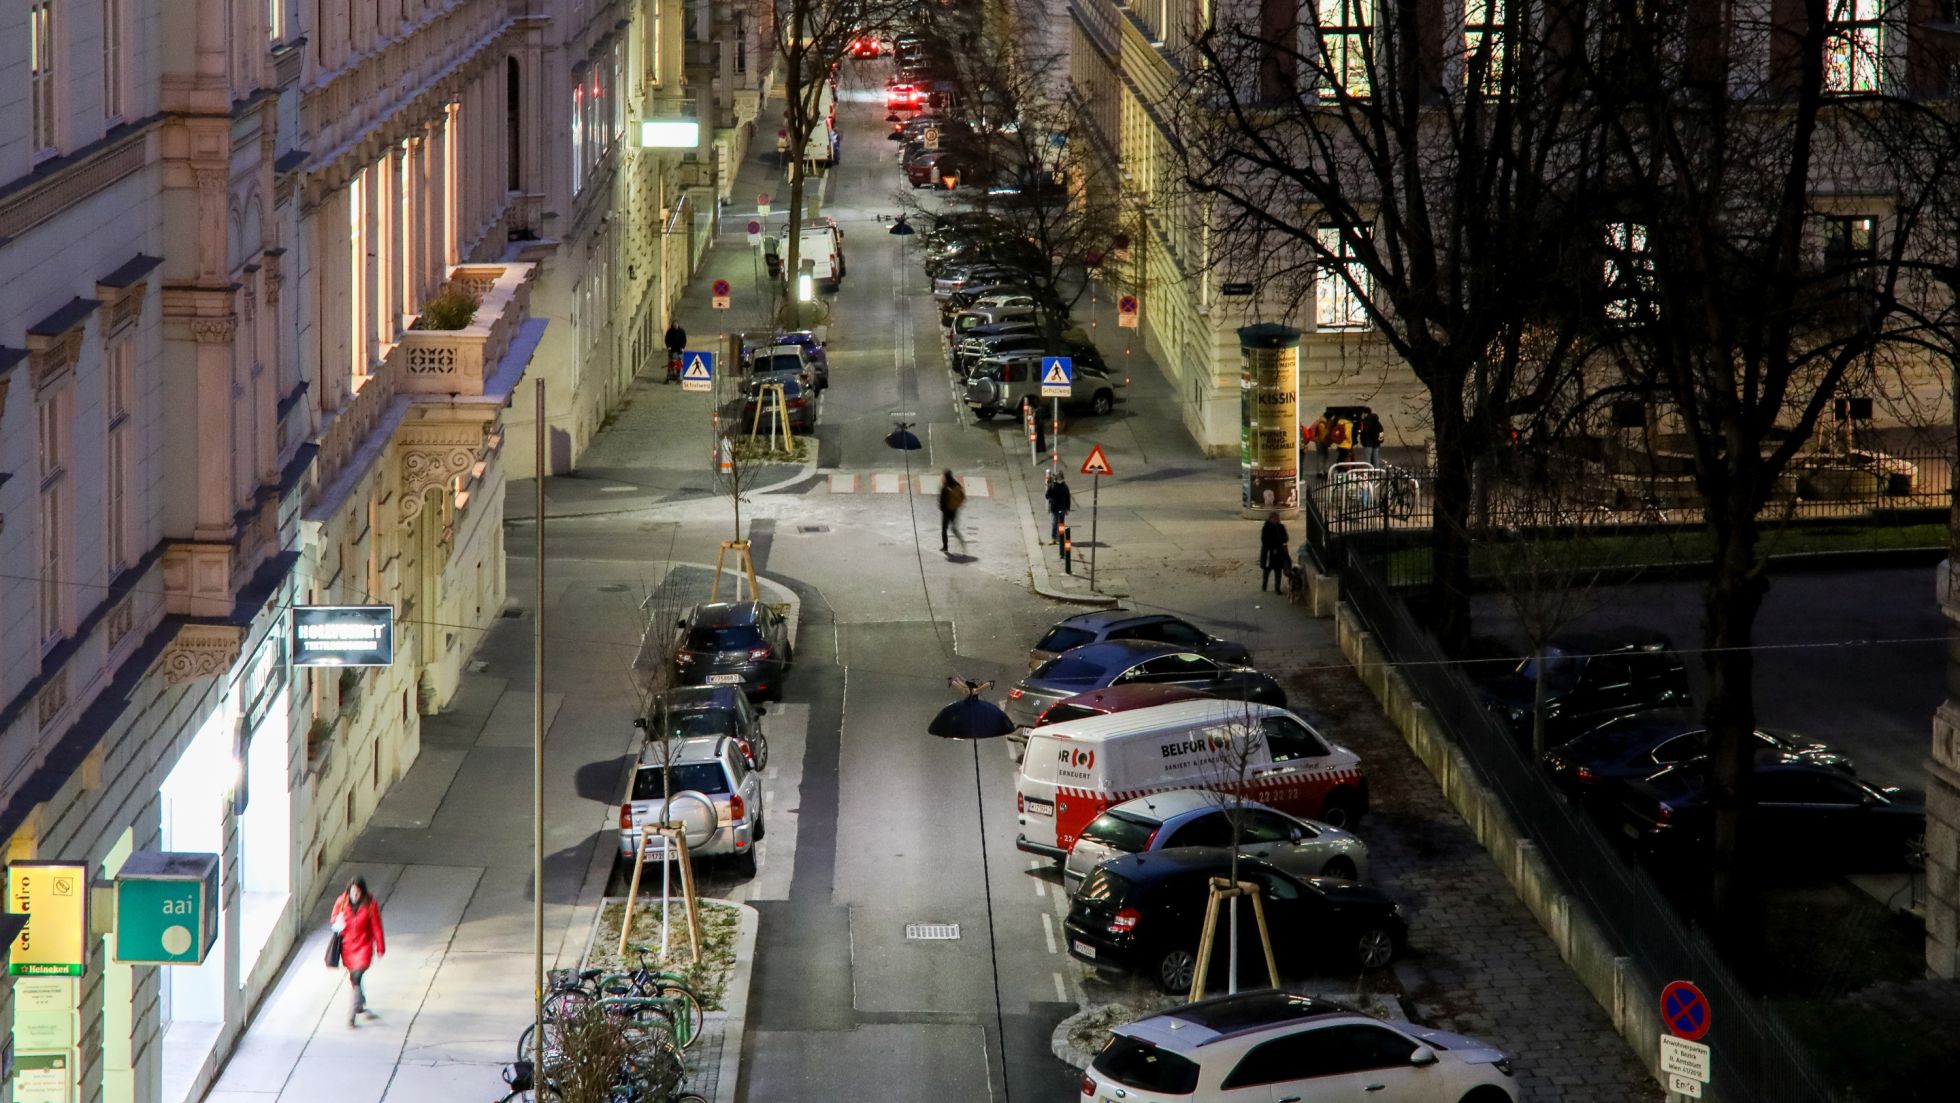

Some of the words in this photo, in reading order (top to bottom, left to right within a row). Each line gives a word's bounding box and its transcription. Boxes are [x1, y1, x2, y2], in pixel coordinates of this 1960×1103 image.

[1259, 391, 1296, 405] KISSIN
[1161, 739, 1206, 757] BELFOR
[1058, 769, 1091, 780] ERNEUERT
[15, 876, 31, 911] afro
[162, 894, 193, 915] aai
[29, 964, 70, 974] Heineken
